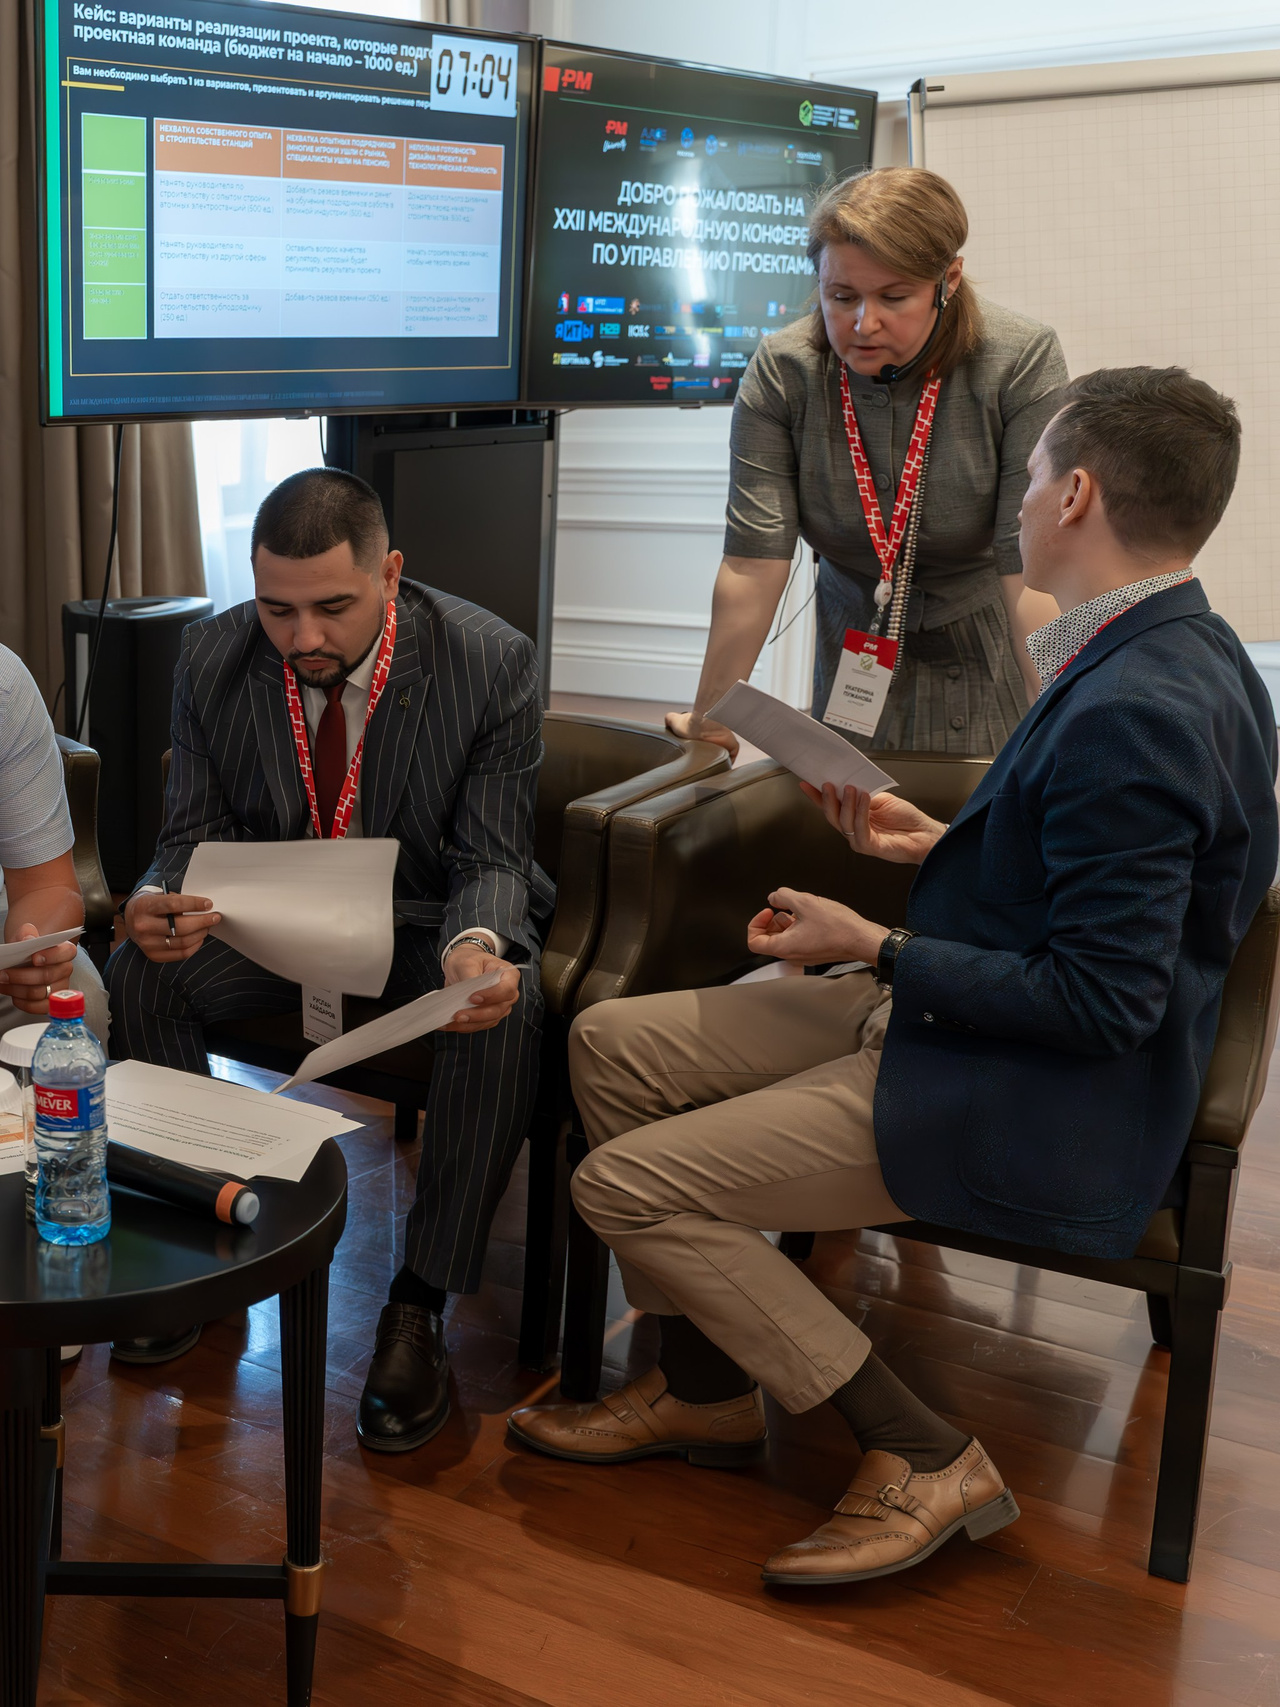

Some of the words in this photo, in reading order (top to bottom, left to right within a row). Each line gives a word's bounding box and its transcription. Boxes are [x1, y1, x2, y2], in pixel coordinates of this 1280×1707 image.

[73, 2, 116, 22] Кейс:
[118, 11, 192, 31] варианты
[195, 20, 280, 41] реализации
[282, 30, 341, 50] проекта,
[343, 38, 398, 59] которые
[73, 24, 154, 45] проектная
[158, 34, 221, 54] команда
[224, 38, 285, 59] (бюджет
[286, 45, 303, 61] на
[306, 51, 353, 66] начало
[363, 54, 393, 71] 1000
[394, 58, 417, 77] ед.)
[436, 49, 512, 100] 07:04
[616, 180, 677, 207] ДОБРО
[679, 186, 784, 217] ПОЖАЛОВАТЬ
[783, 195, 806, 218] НА
[552, 206, 586, 232] XXII
[587, 210, 741, 243] МЕЖДУНАРОДНУЮ
[741, 222, 810, 248] КОНФЕРЕ
[591, 241, 619, 266] ПО
[619, 243, 731, 272] УПРАВЛЕНИЮ
